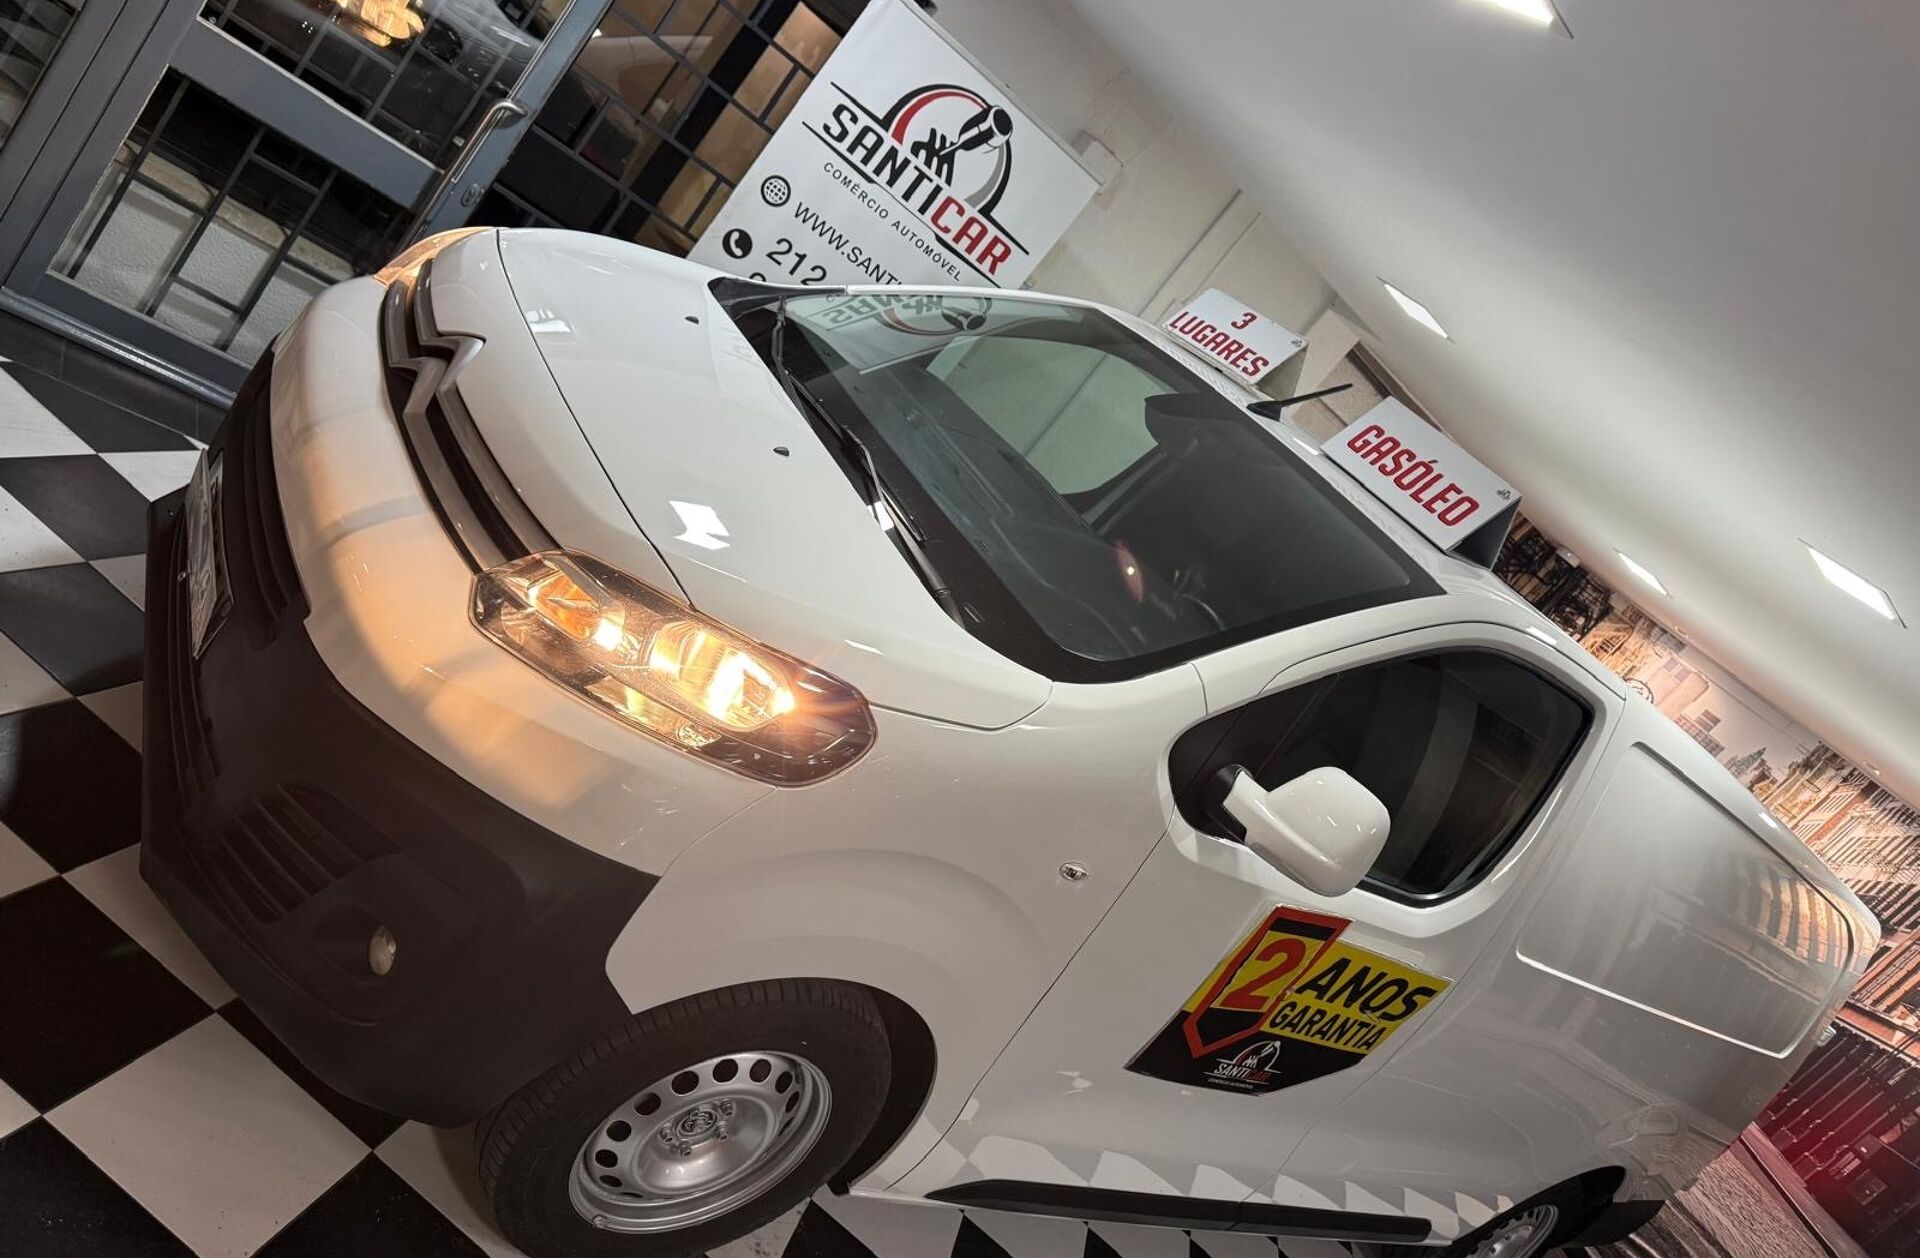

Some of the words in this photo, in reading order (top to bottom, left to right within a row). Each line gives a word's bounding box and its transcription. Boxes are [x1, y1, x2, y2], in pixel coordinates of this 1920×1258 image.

[823, 103, 1012, 276] SANTICAR
[823, 162, 889, 220] COMÉRCIO
[891, 220, 962, 281] AUTOMÓVEL
[794, 201, 902, 285] WWW.SANT
[1169, 311, 1269, 377] LUGARES
[1230, 312, 1257, 330] 3
[1346, 424, 1480, 527] GASÓLEO
[1219, 938, 1307, 1011] 2
[1294, 957, 1438, 1022] ANOS
[1269, 1001, 1387, 1051] GARANTIA
